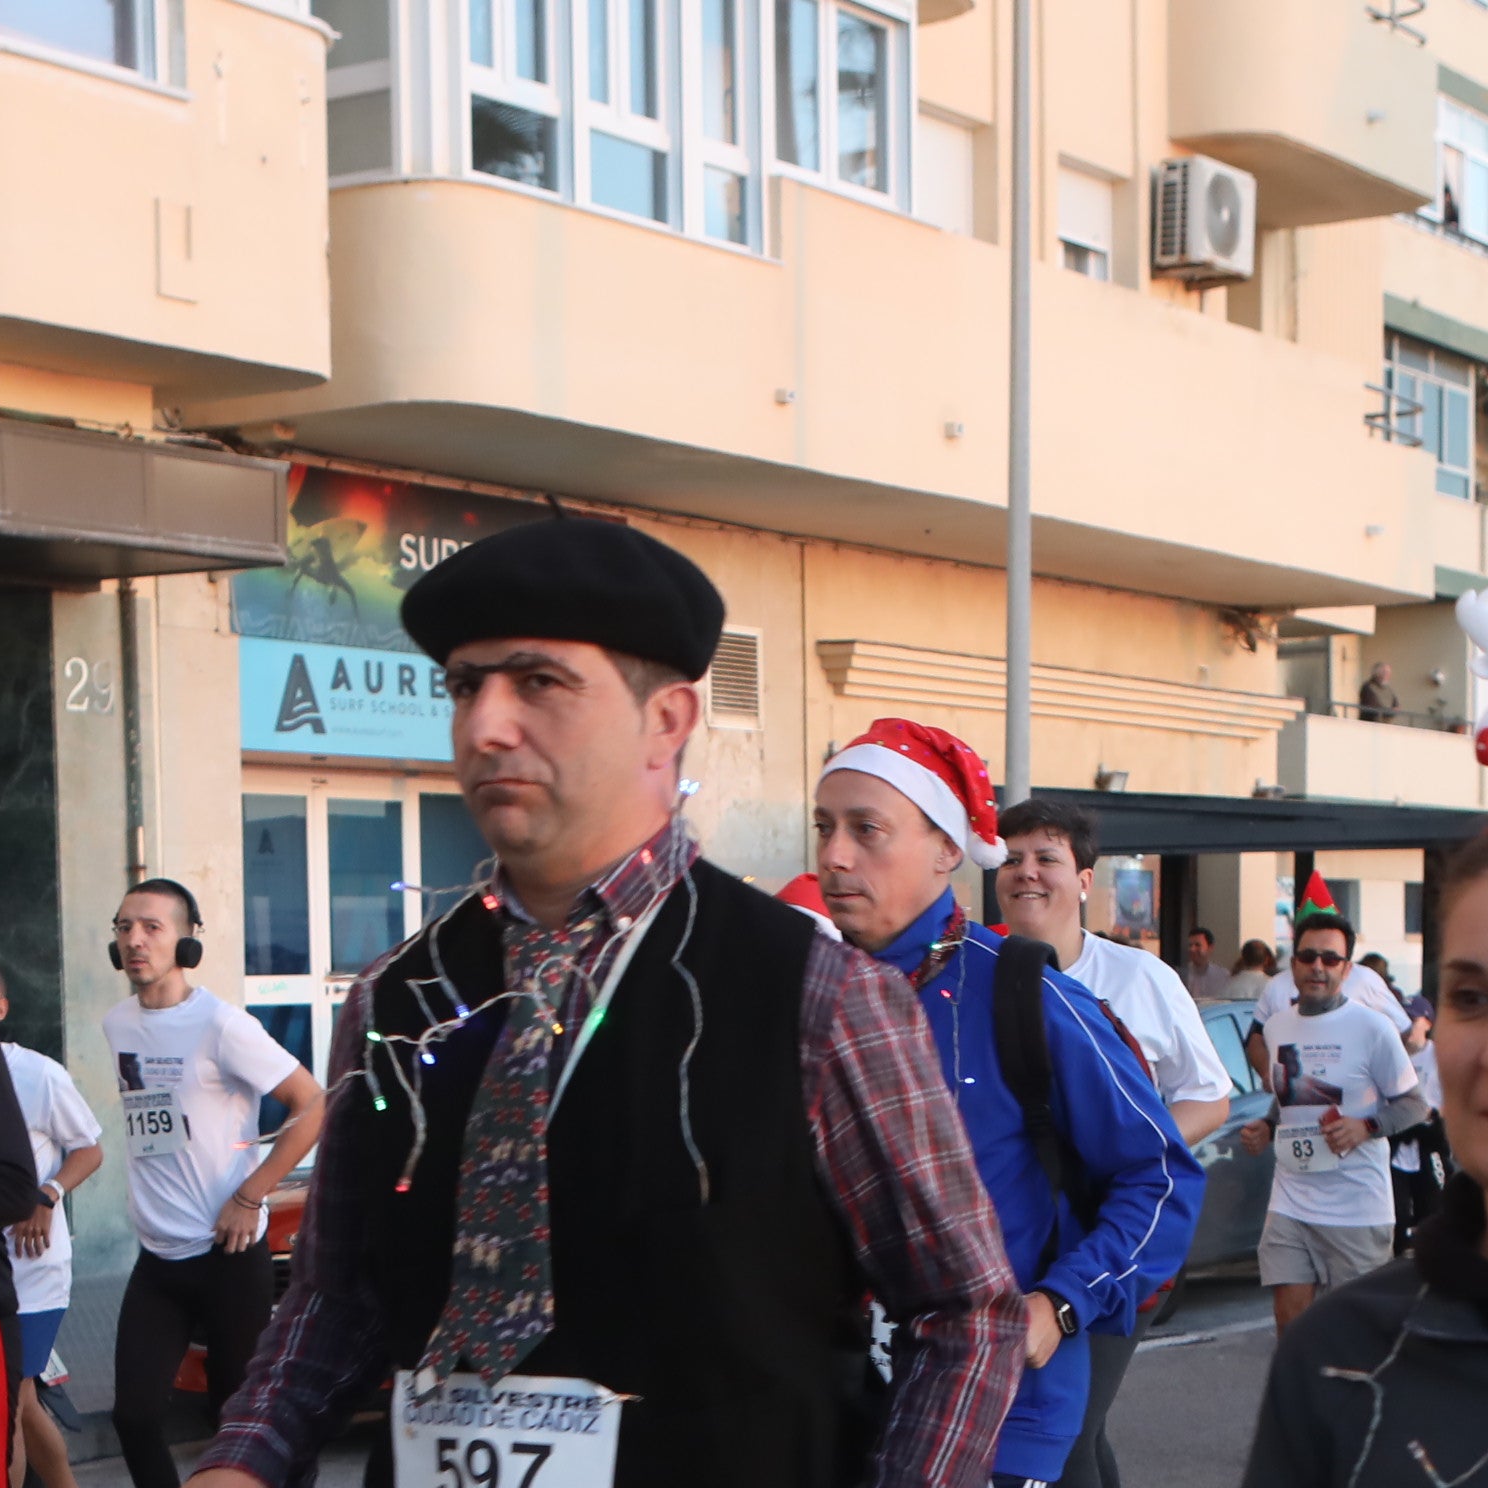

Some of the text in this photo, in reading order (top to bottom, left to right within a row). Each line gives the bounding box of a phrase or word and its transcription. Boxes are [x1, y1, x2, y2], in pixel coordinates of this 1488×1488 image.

[400, 533, 474, 571] SUR
[64, 656, 115, 717] 29
[330, 697, 363, 711] SURF
[372, 700, 425, 717] SCHOOL
[127, 1110, 173, 1136] 1159
[1292, 1140, 1314, 1157] 83
